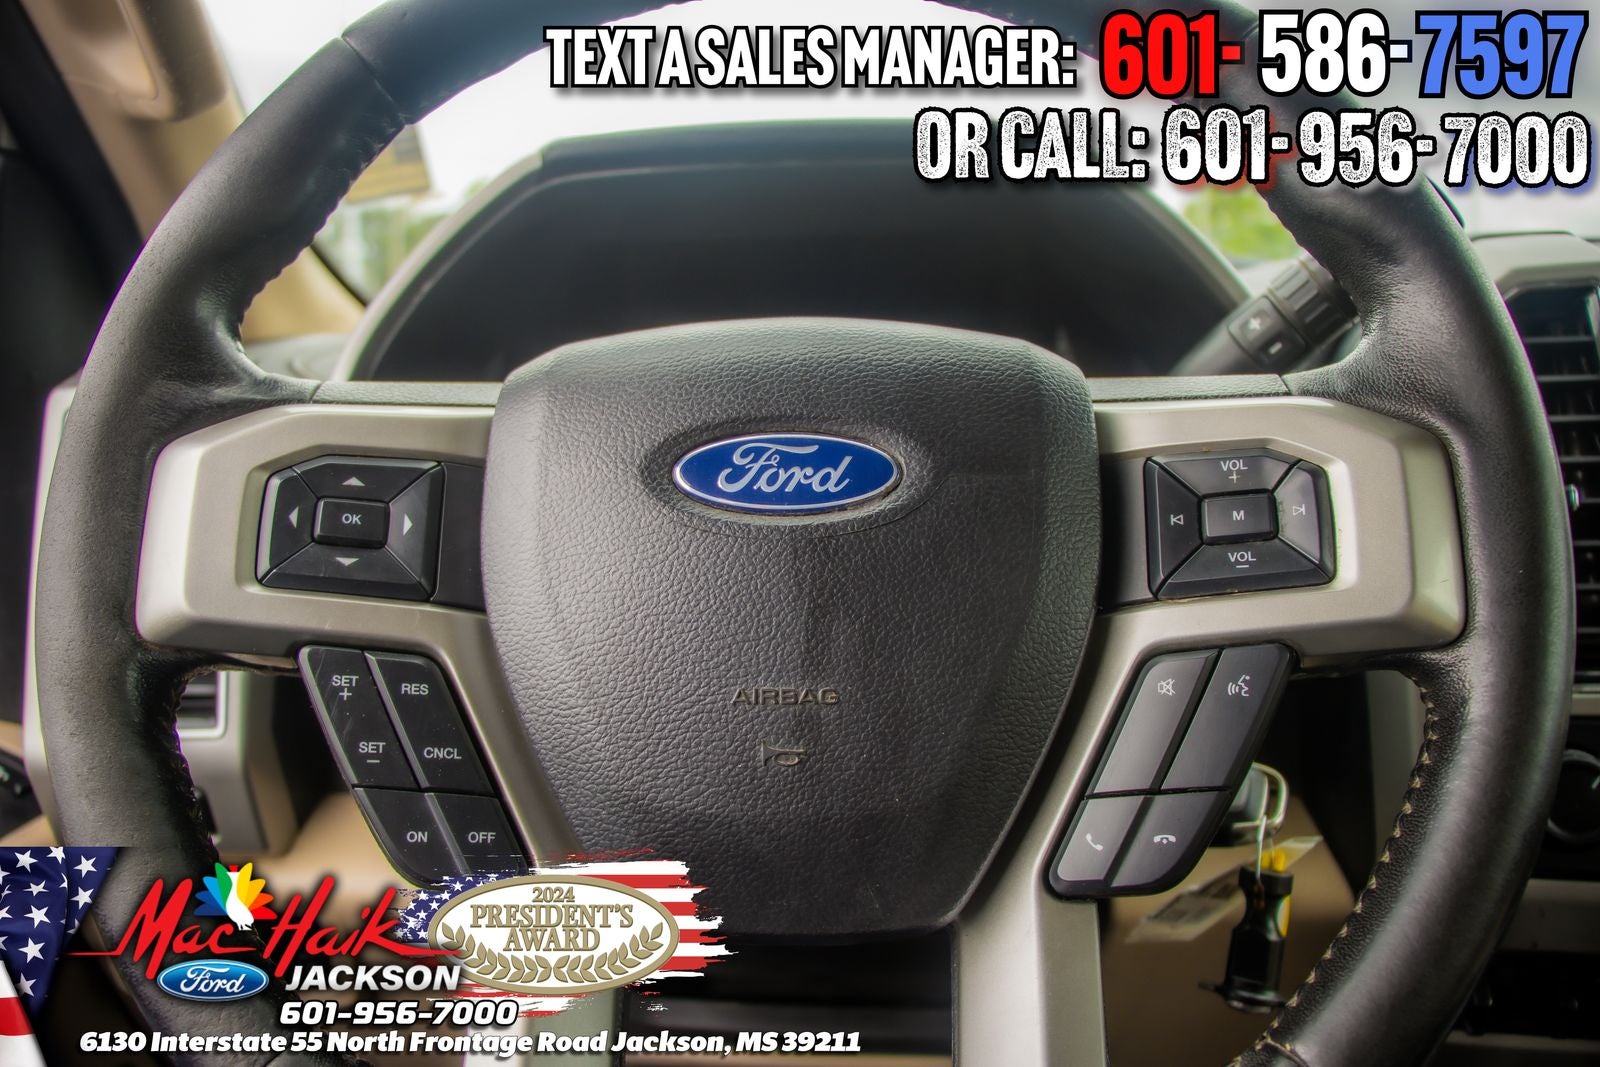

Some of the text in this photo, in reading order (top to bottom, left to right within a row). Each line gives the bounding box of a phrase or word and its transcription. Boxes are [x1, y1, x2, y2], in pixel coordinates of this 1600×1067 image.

[717, 443, 852, 493] Ford
[1220, 459, 1248, 471] VOL
[341, 512, 362, 525] OK
[1232, 510, 1245, 521] M
[1228, 551, 1256, 562] VOL
[331, 675, 359, 687] SET
[401, 683, 429, 696] RES
[731, 687, 840, 705] AIRBAG
[358, 741, 386, 753] SET
[423, 746, 462, 760] CNCL
[406, 831, 428, 843] ON
[468, 831, 496, 844] OFF
